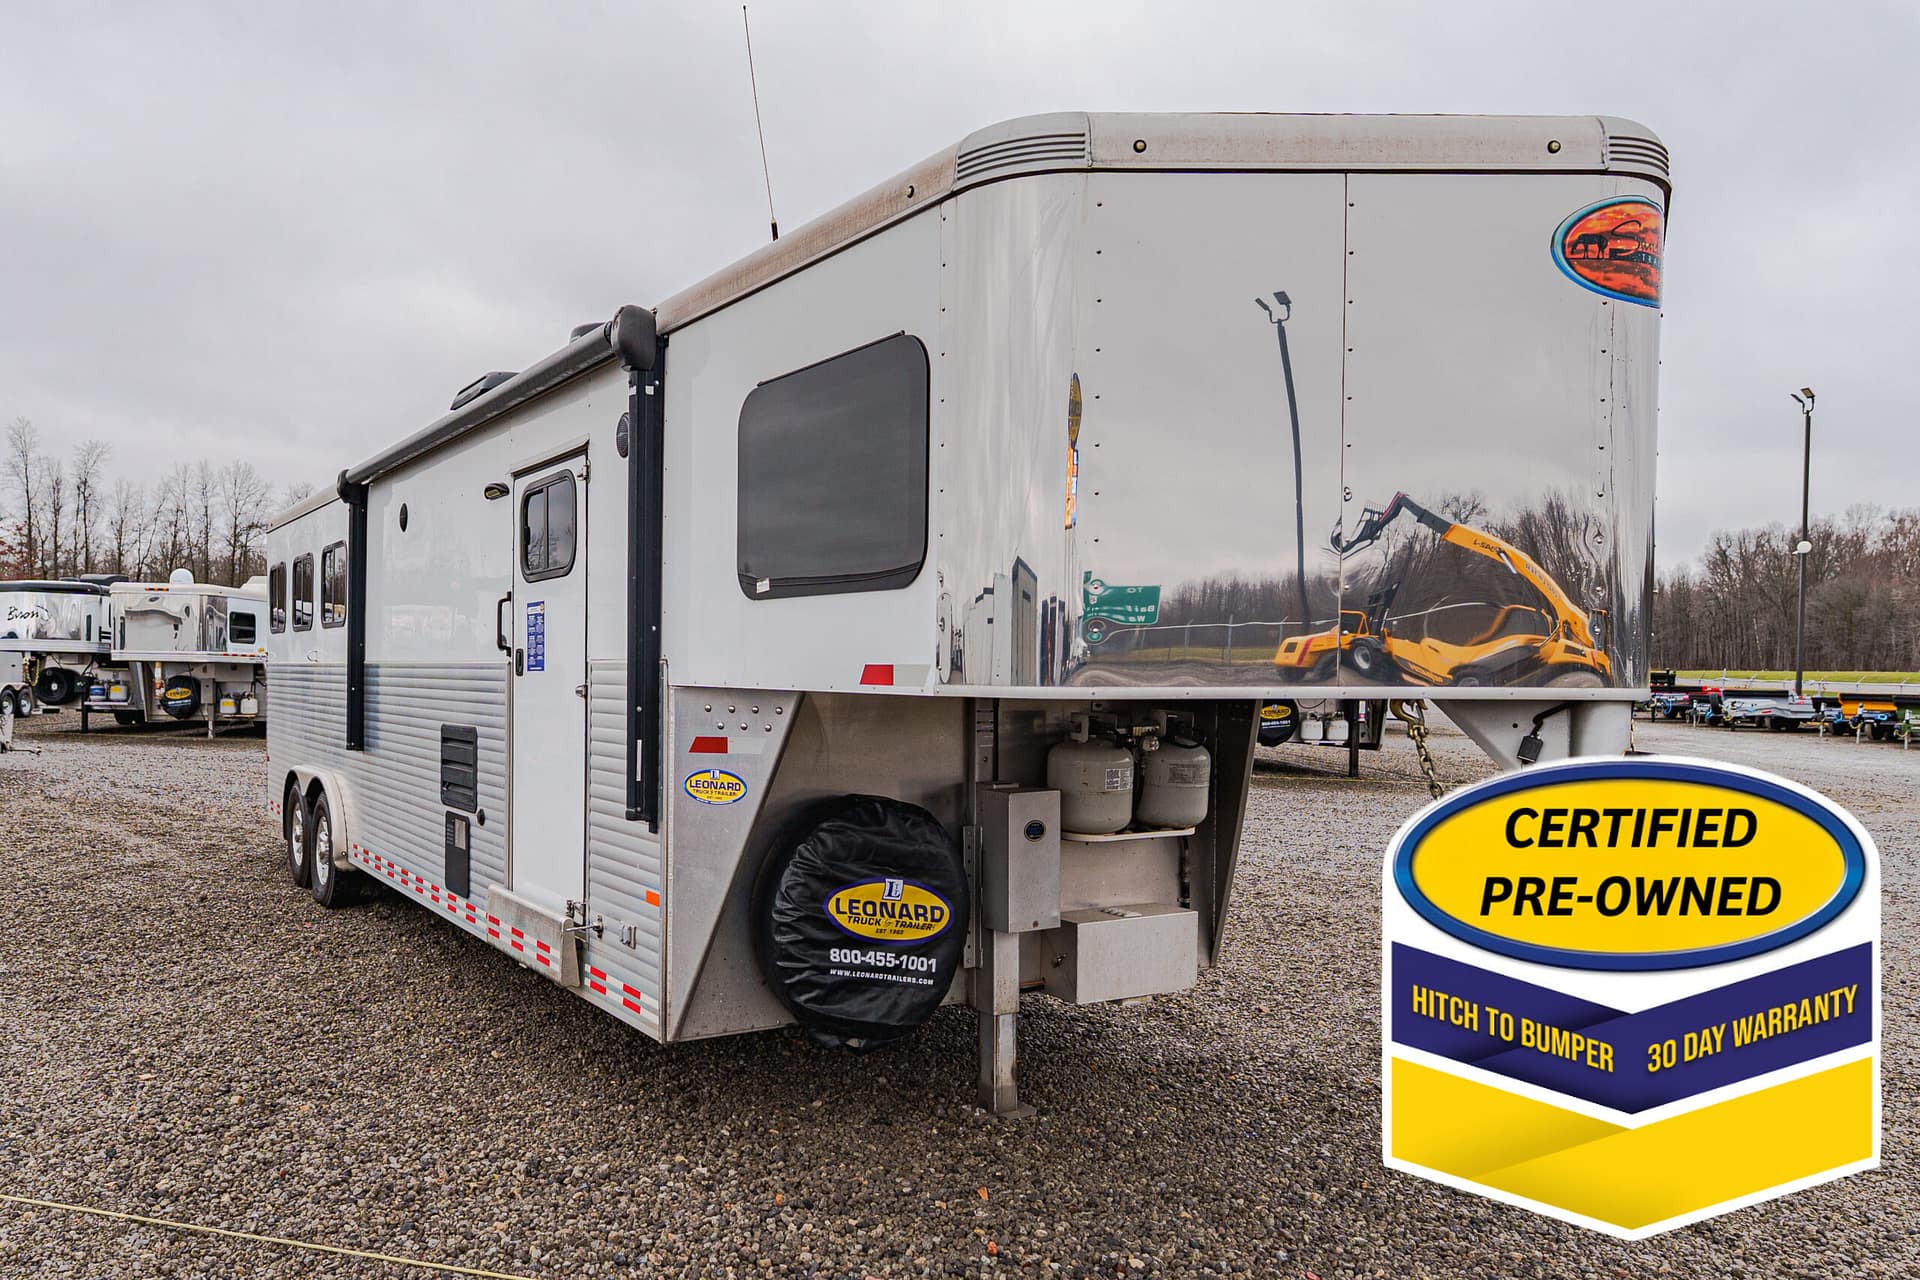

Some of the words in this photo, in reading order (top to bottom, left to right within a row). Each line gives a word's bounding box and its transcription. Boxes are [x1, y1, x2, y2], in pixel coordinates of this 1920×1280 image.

[689, 779, 741, 792] LEONARD
[834, 897, 945, 923] LEONARD
[847, 915, 882, 926] TRUCK
[894, 919, 935, 932] TRAILER
[829, 947, 938, 974] 800-455-1001
[829, 968, 934, 986] WWW.LEONARDTRAILERS.COM
